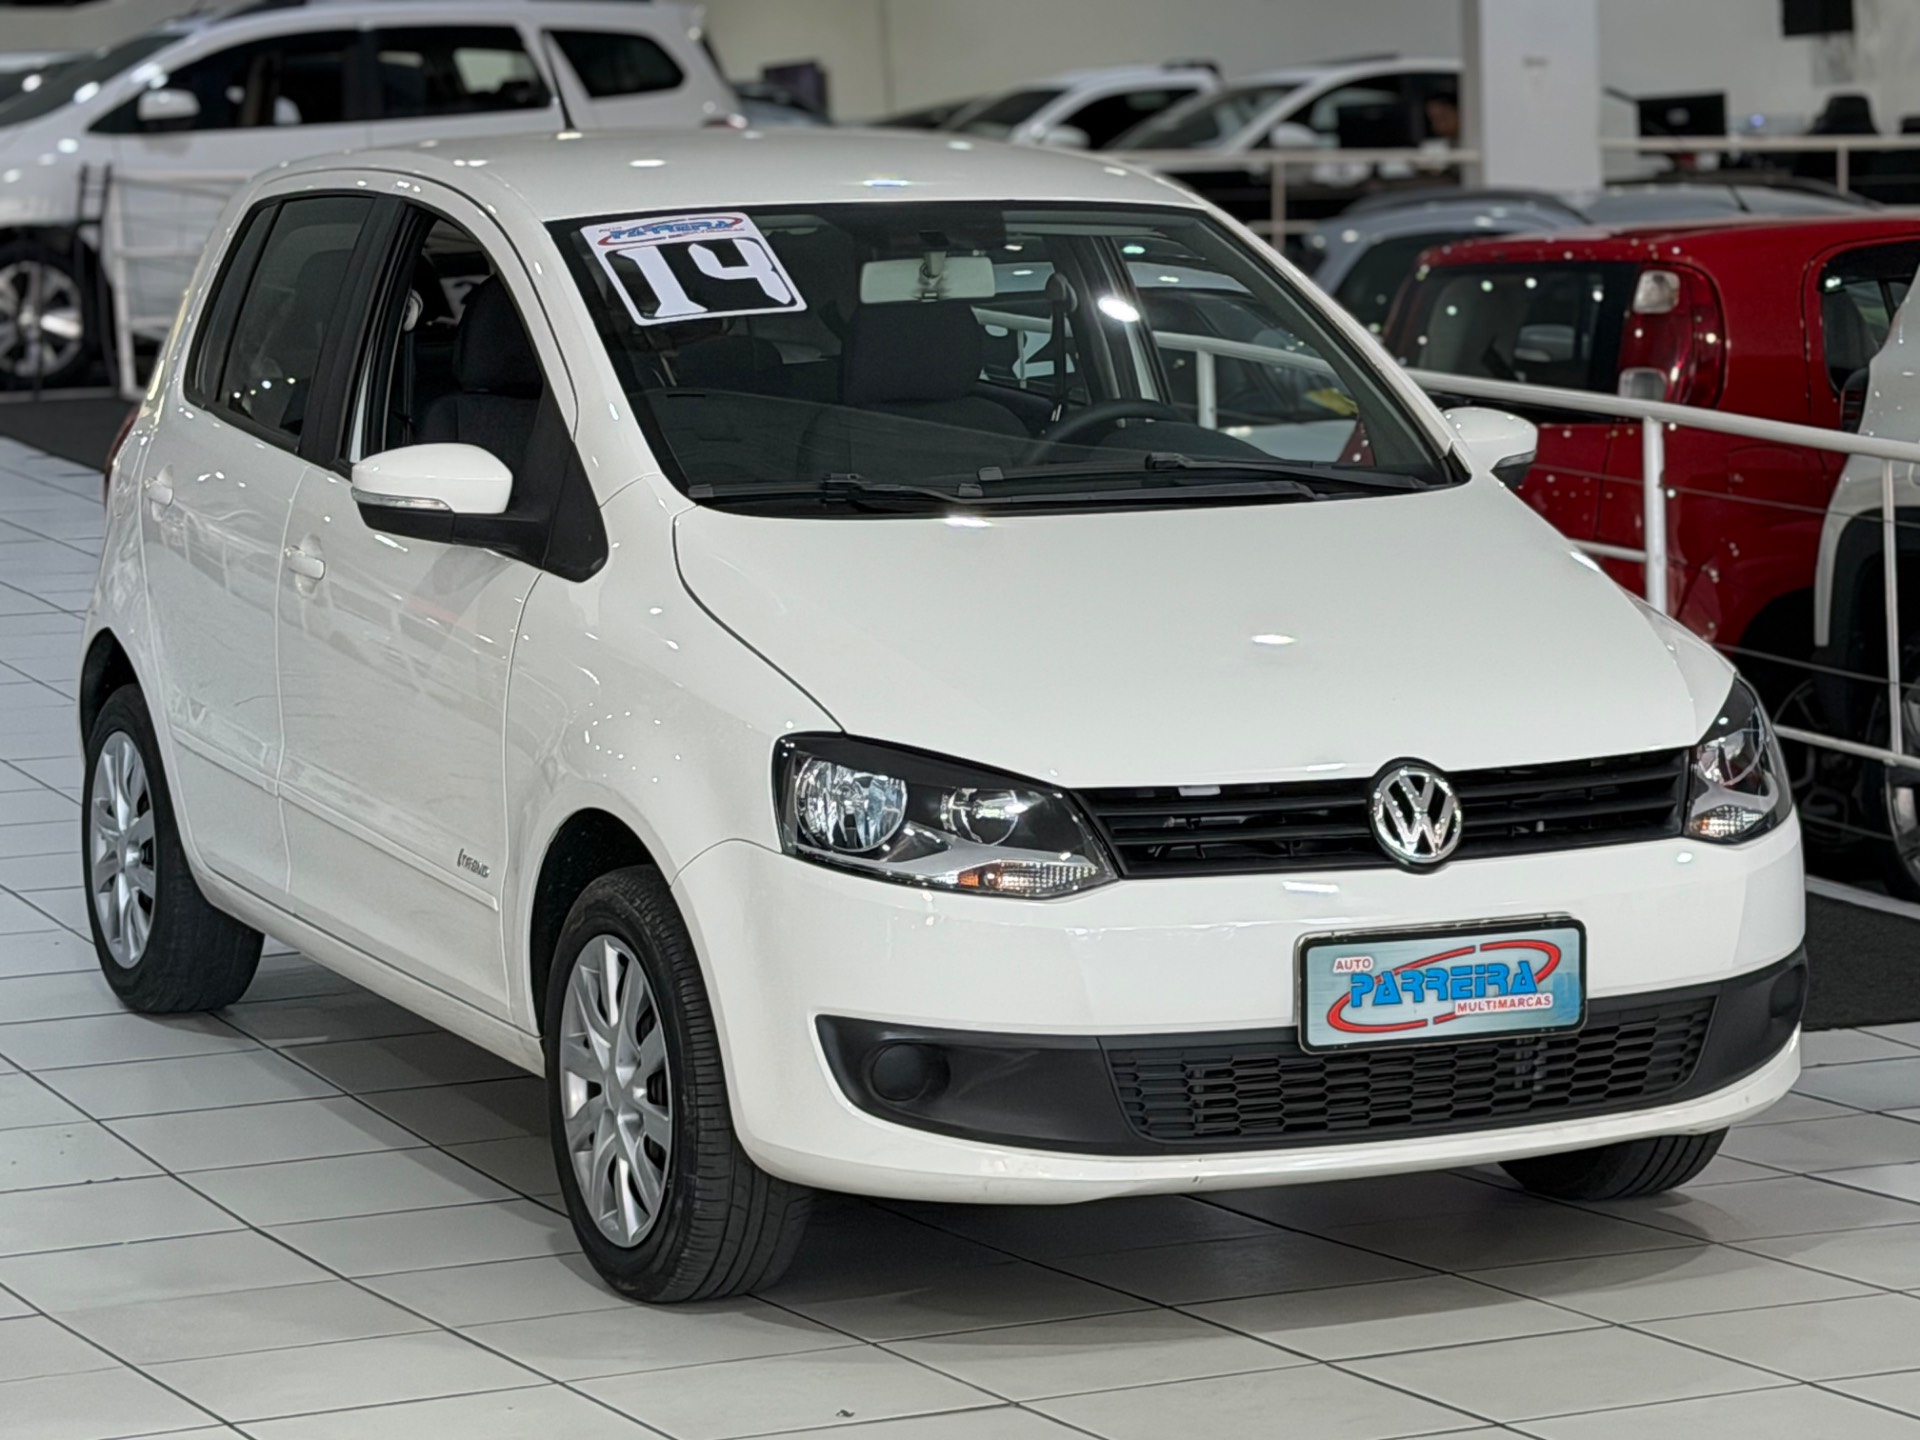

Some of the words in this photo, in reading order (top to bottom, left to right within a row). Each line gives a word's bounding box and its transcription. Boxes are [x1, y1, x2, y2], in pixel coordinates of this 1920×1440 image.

[616, 238, 791, 317] 14
[1334, 957, 1372, 972] AUTO
[1350, 960, 1538, 1008] PARREIRA
[1456, 995, 1552, 1013] MULTIMARCAS
